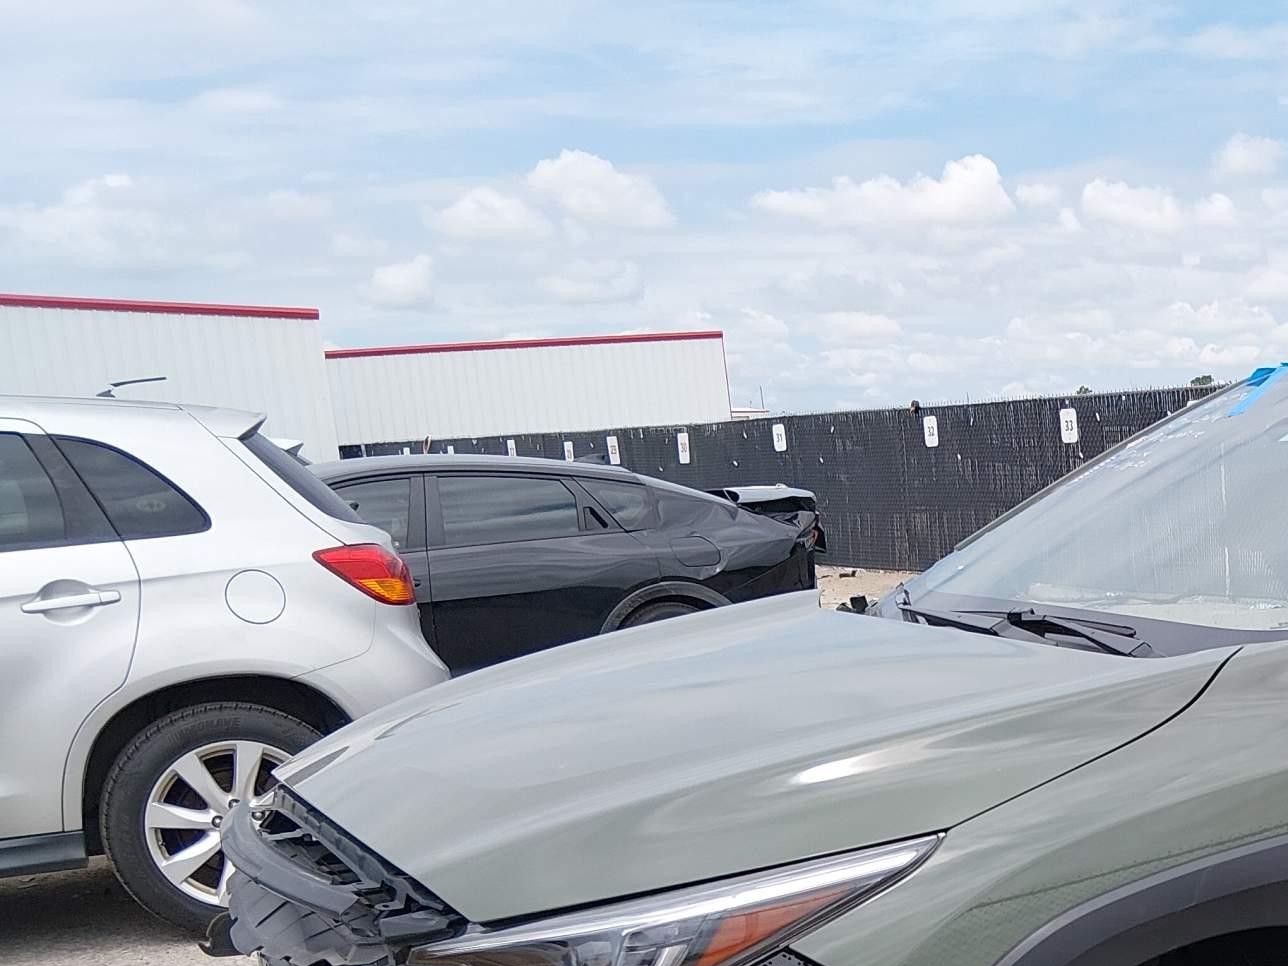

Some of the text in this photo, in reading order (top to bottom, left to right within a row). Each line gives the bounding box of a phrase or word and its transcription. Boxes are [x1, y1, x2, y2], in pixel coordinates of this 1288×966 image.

[1064, 420, 1074, 431] 33
[927, 426, 936, 436] 32
[775, 433, 783, 443] 31
